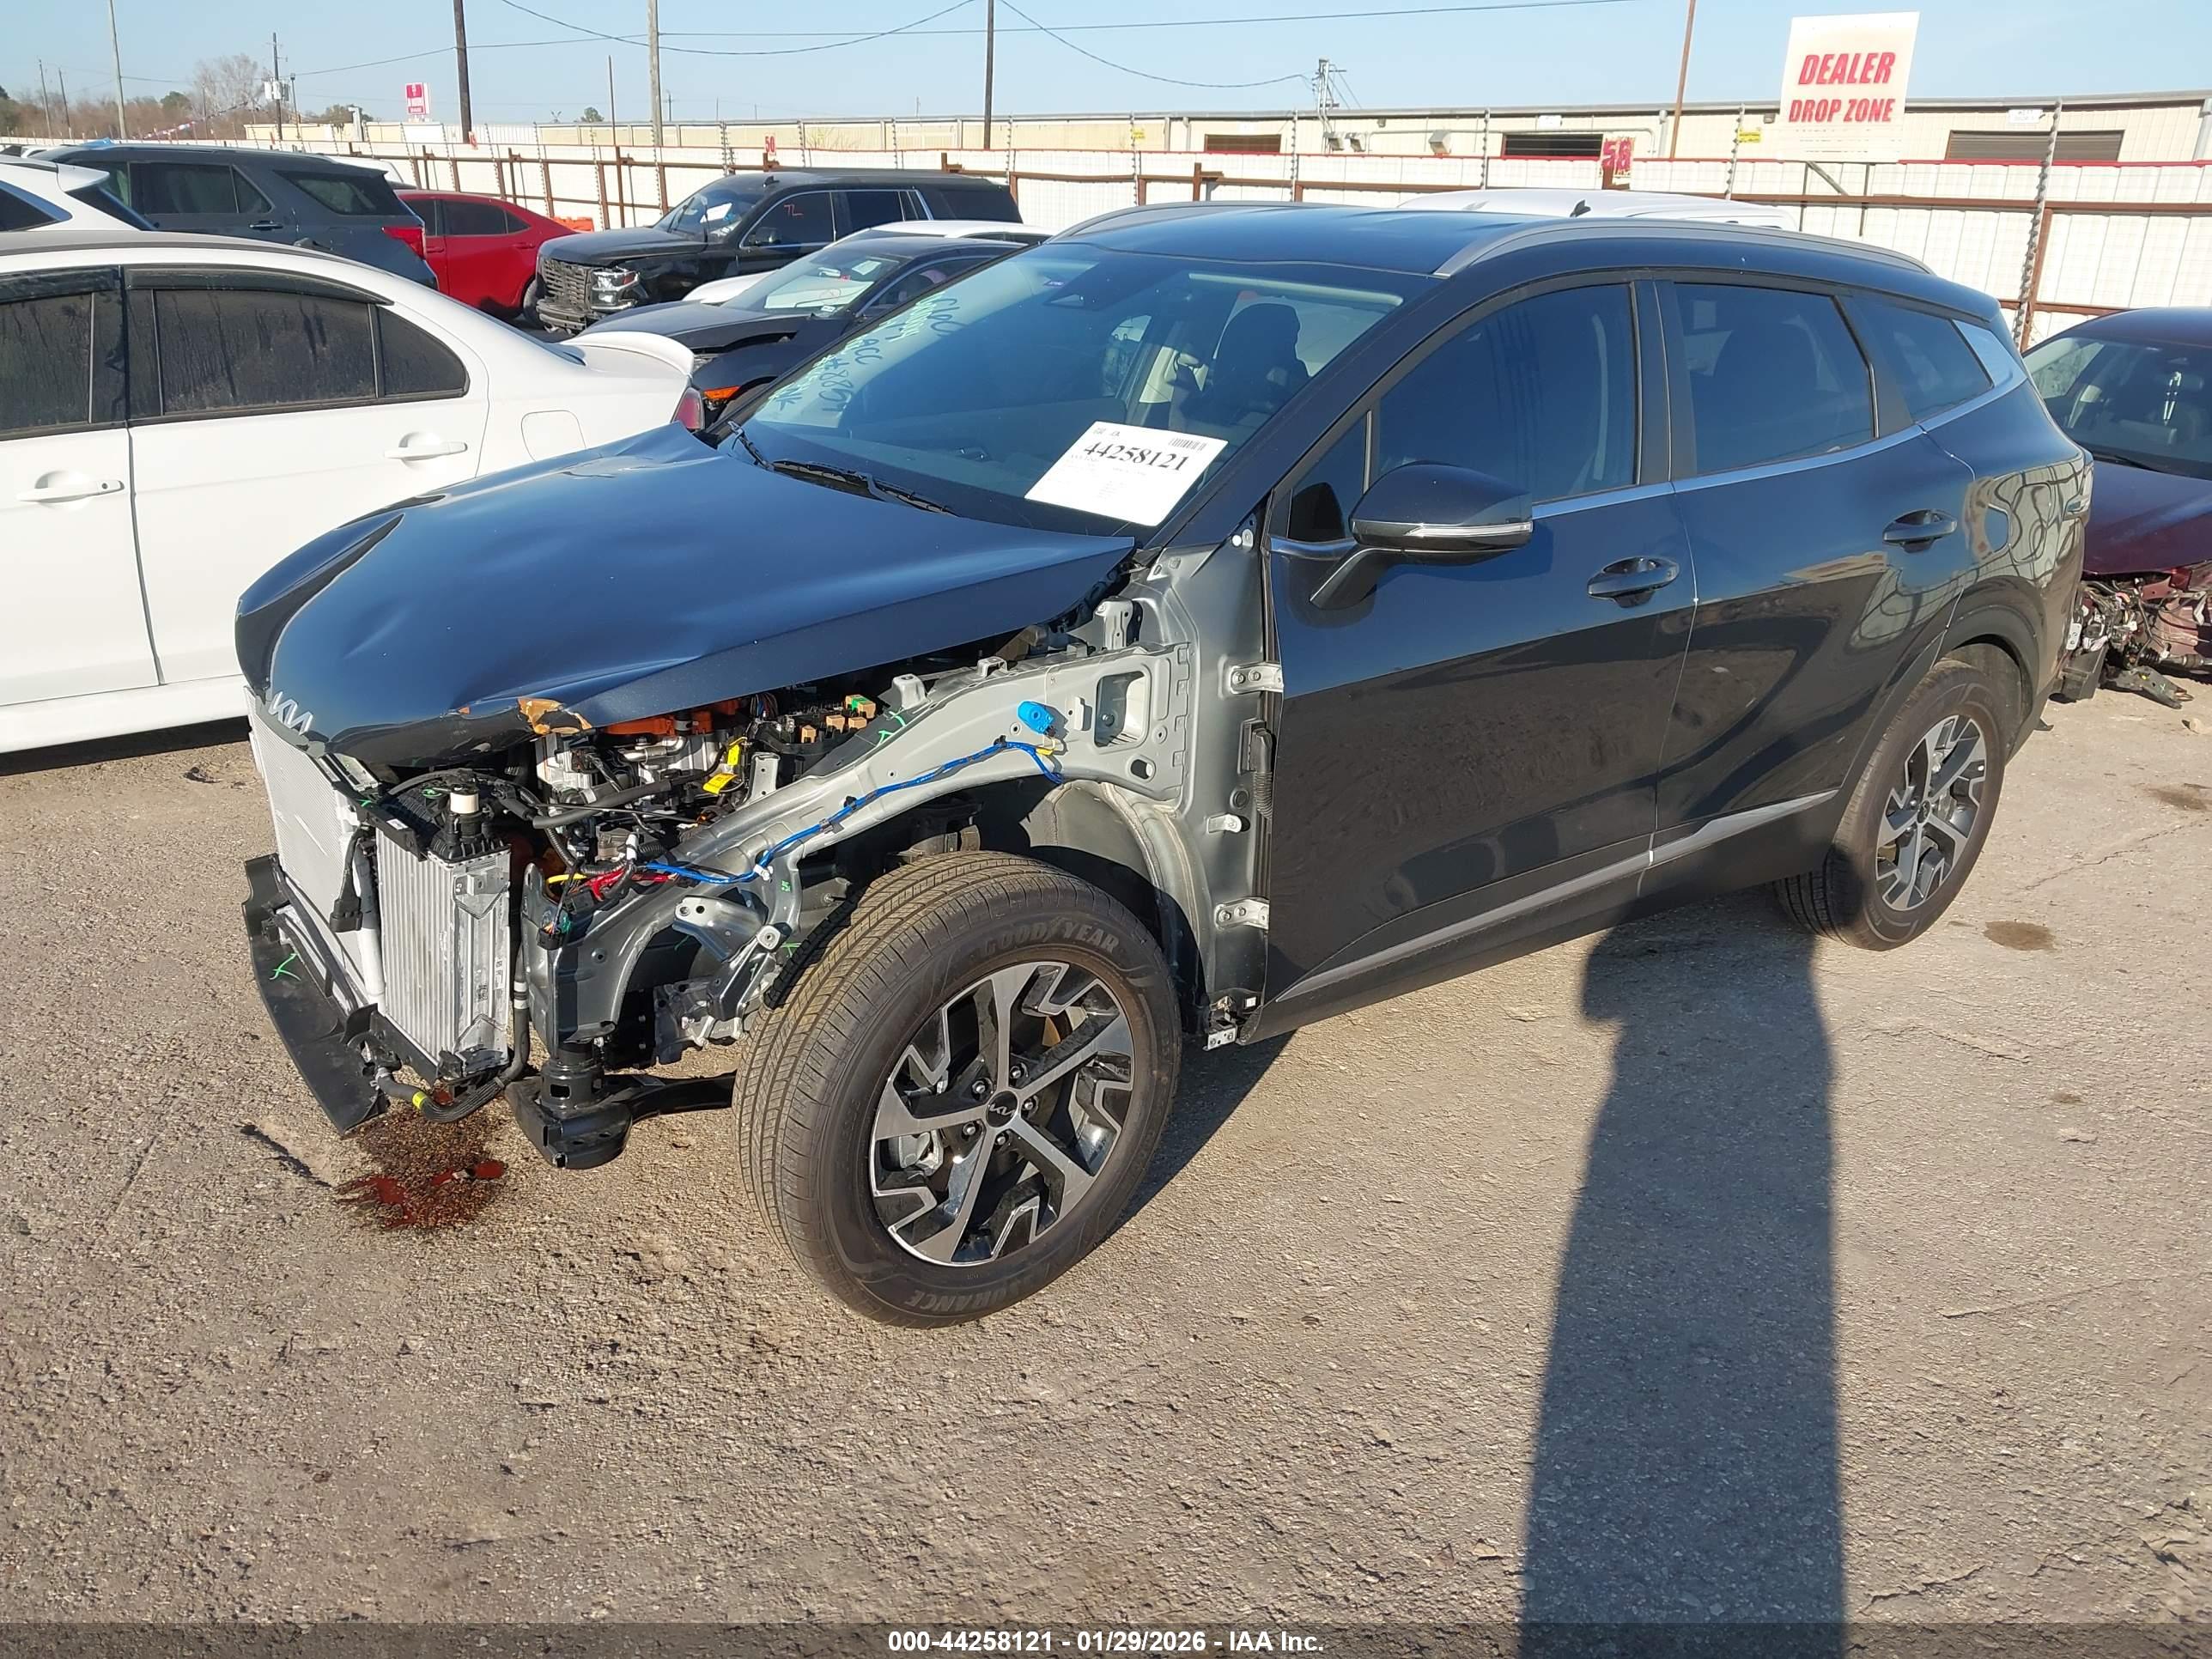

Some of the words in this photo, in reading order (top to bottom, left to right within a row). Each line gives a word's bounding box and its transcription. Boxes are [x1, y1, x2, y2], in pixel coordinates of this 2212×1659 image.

[1798, 52, 1896, 84] DEALER
[1789, 99, 1842, 122] DROP
[1844, 99, 1896, 122] ZONE
[1084, 441, 1189, 471] 44258121
[268, 690, 313, 736] KIA
